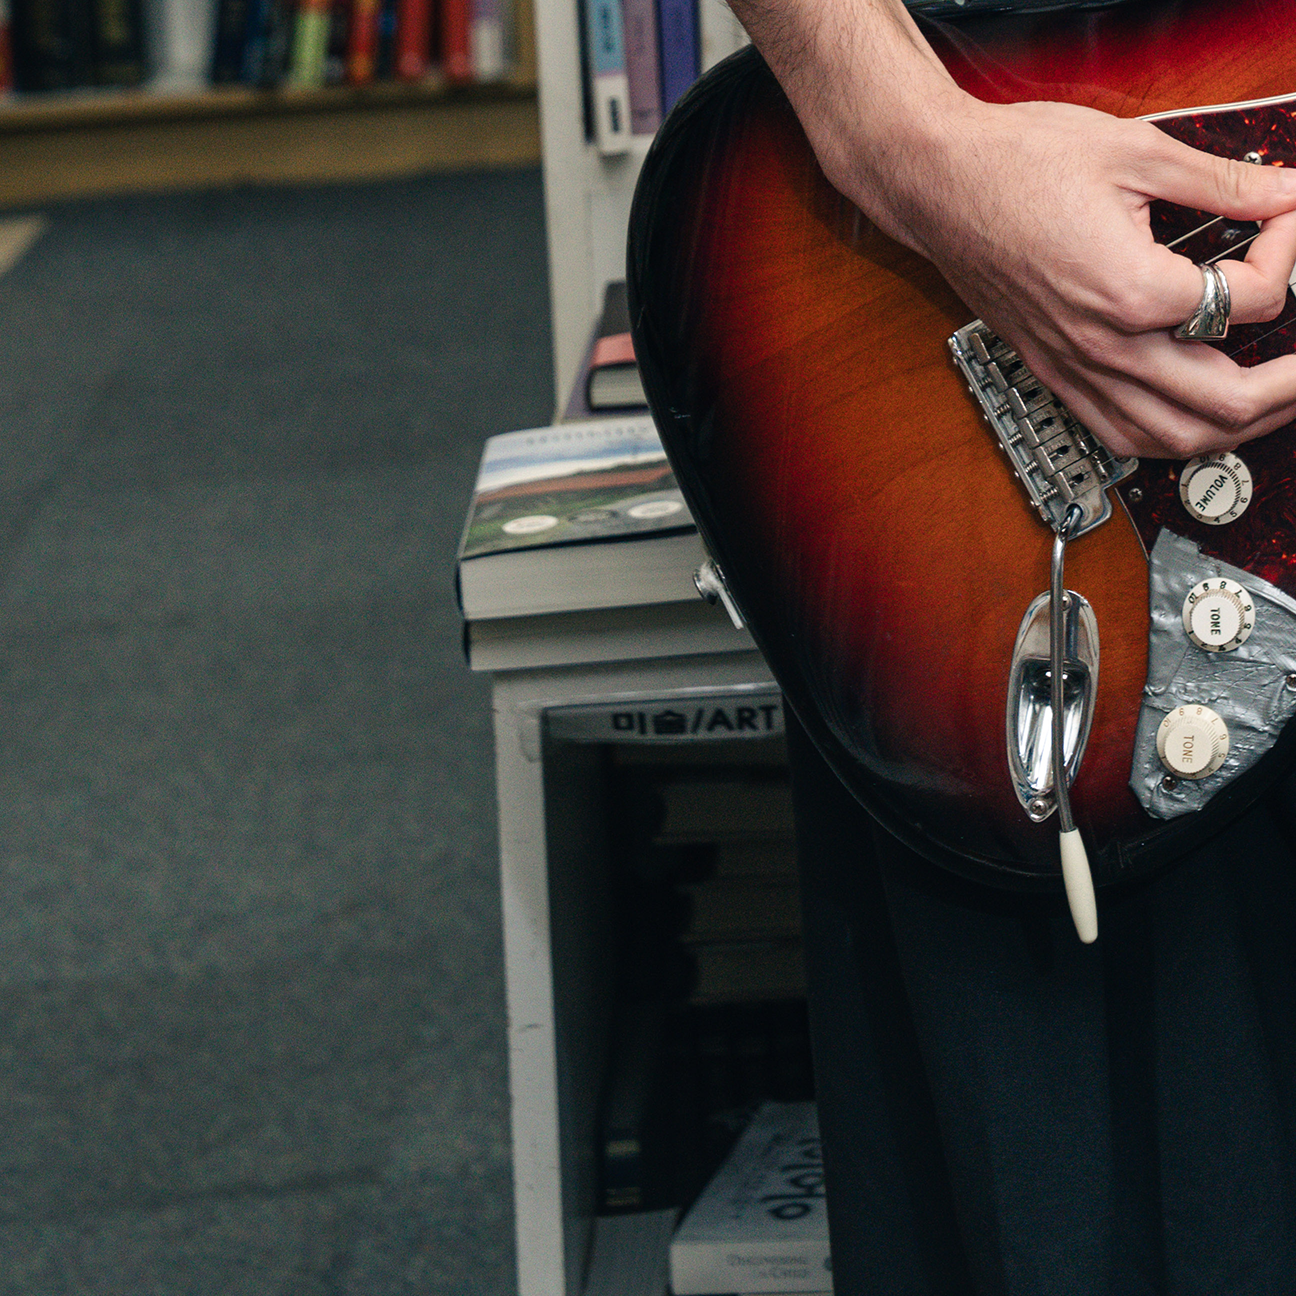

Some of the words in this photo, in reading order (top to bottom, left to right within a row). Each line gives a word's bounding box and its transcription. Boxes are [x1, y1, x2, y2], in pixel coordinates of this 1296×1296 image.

[1195, 474, 1228, 512] VOLUME
[1210, 607, 1221, 636] TONE
[1182, 734, 1195, 764] TONE
